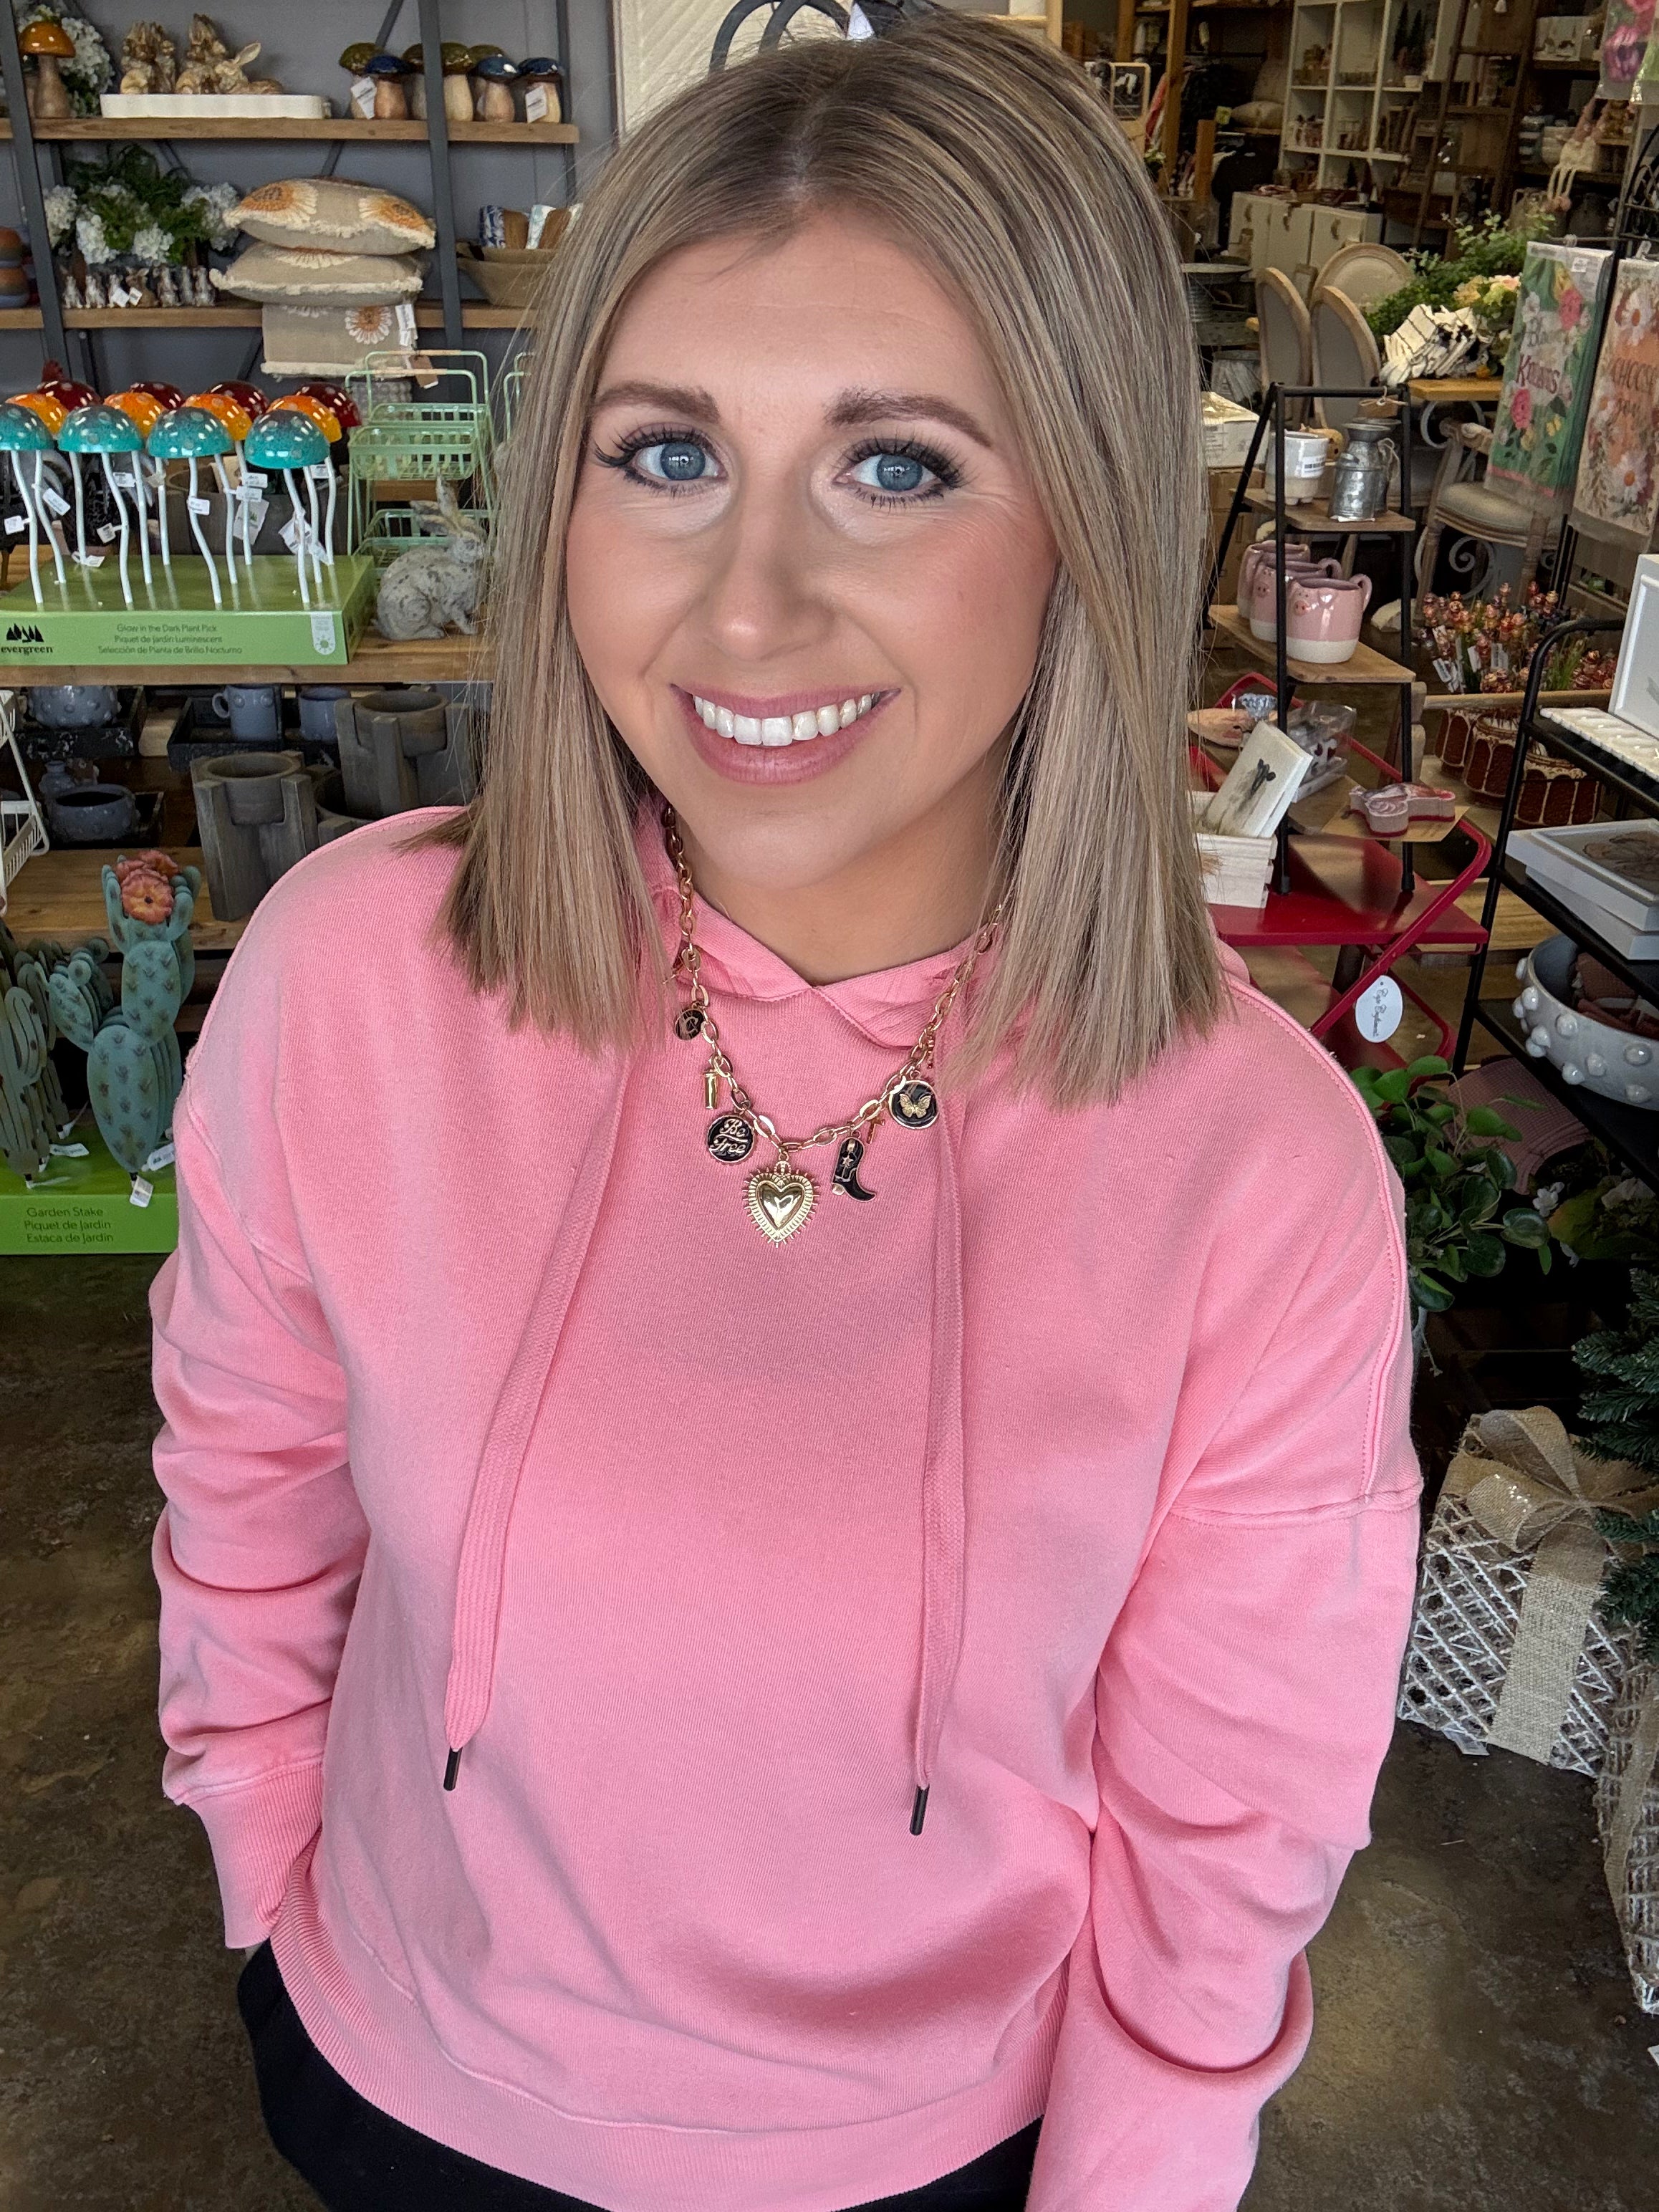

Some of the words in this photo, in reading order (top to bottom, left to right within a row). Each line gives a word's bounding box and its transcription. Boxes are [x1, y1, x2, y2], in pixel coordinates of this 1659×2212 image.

[117, 623, 139, 633] Glow
[181, 624, 200, 633] Plant
[1, 646, 54, 657] evergreen
[718, 1118, 746, 1138] Be
[708, 1134, 749, 1154] Free
[27, 1207, 71, 1218] Garden
[72, 1207, 104, 1217] Stake
[24, 1220, 61, 1231] Piquet
[62, 1220, 78, 1230] de
[27, 1233, 63, 1243] Estaca
[65, 1233, 81, 1243] de
